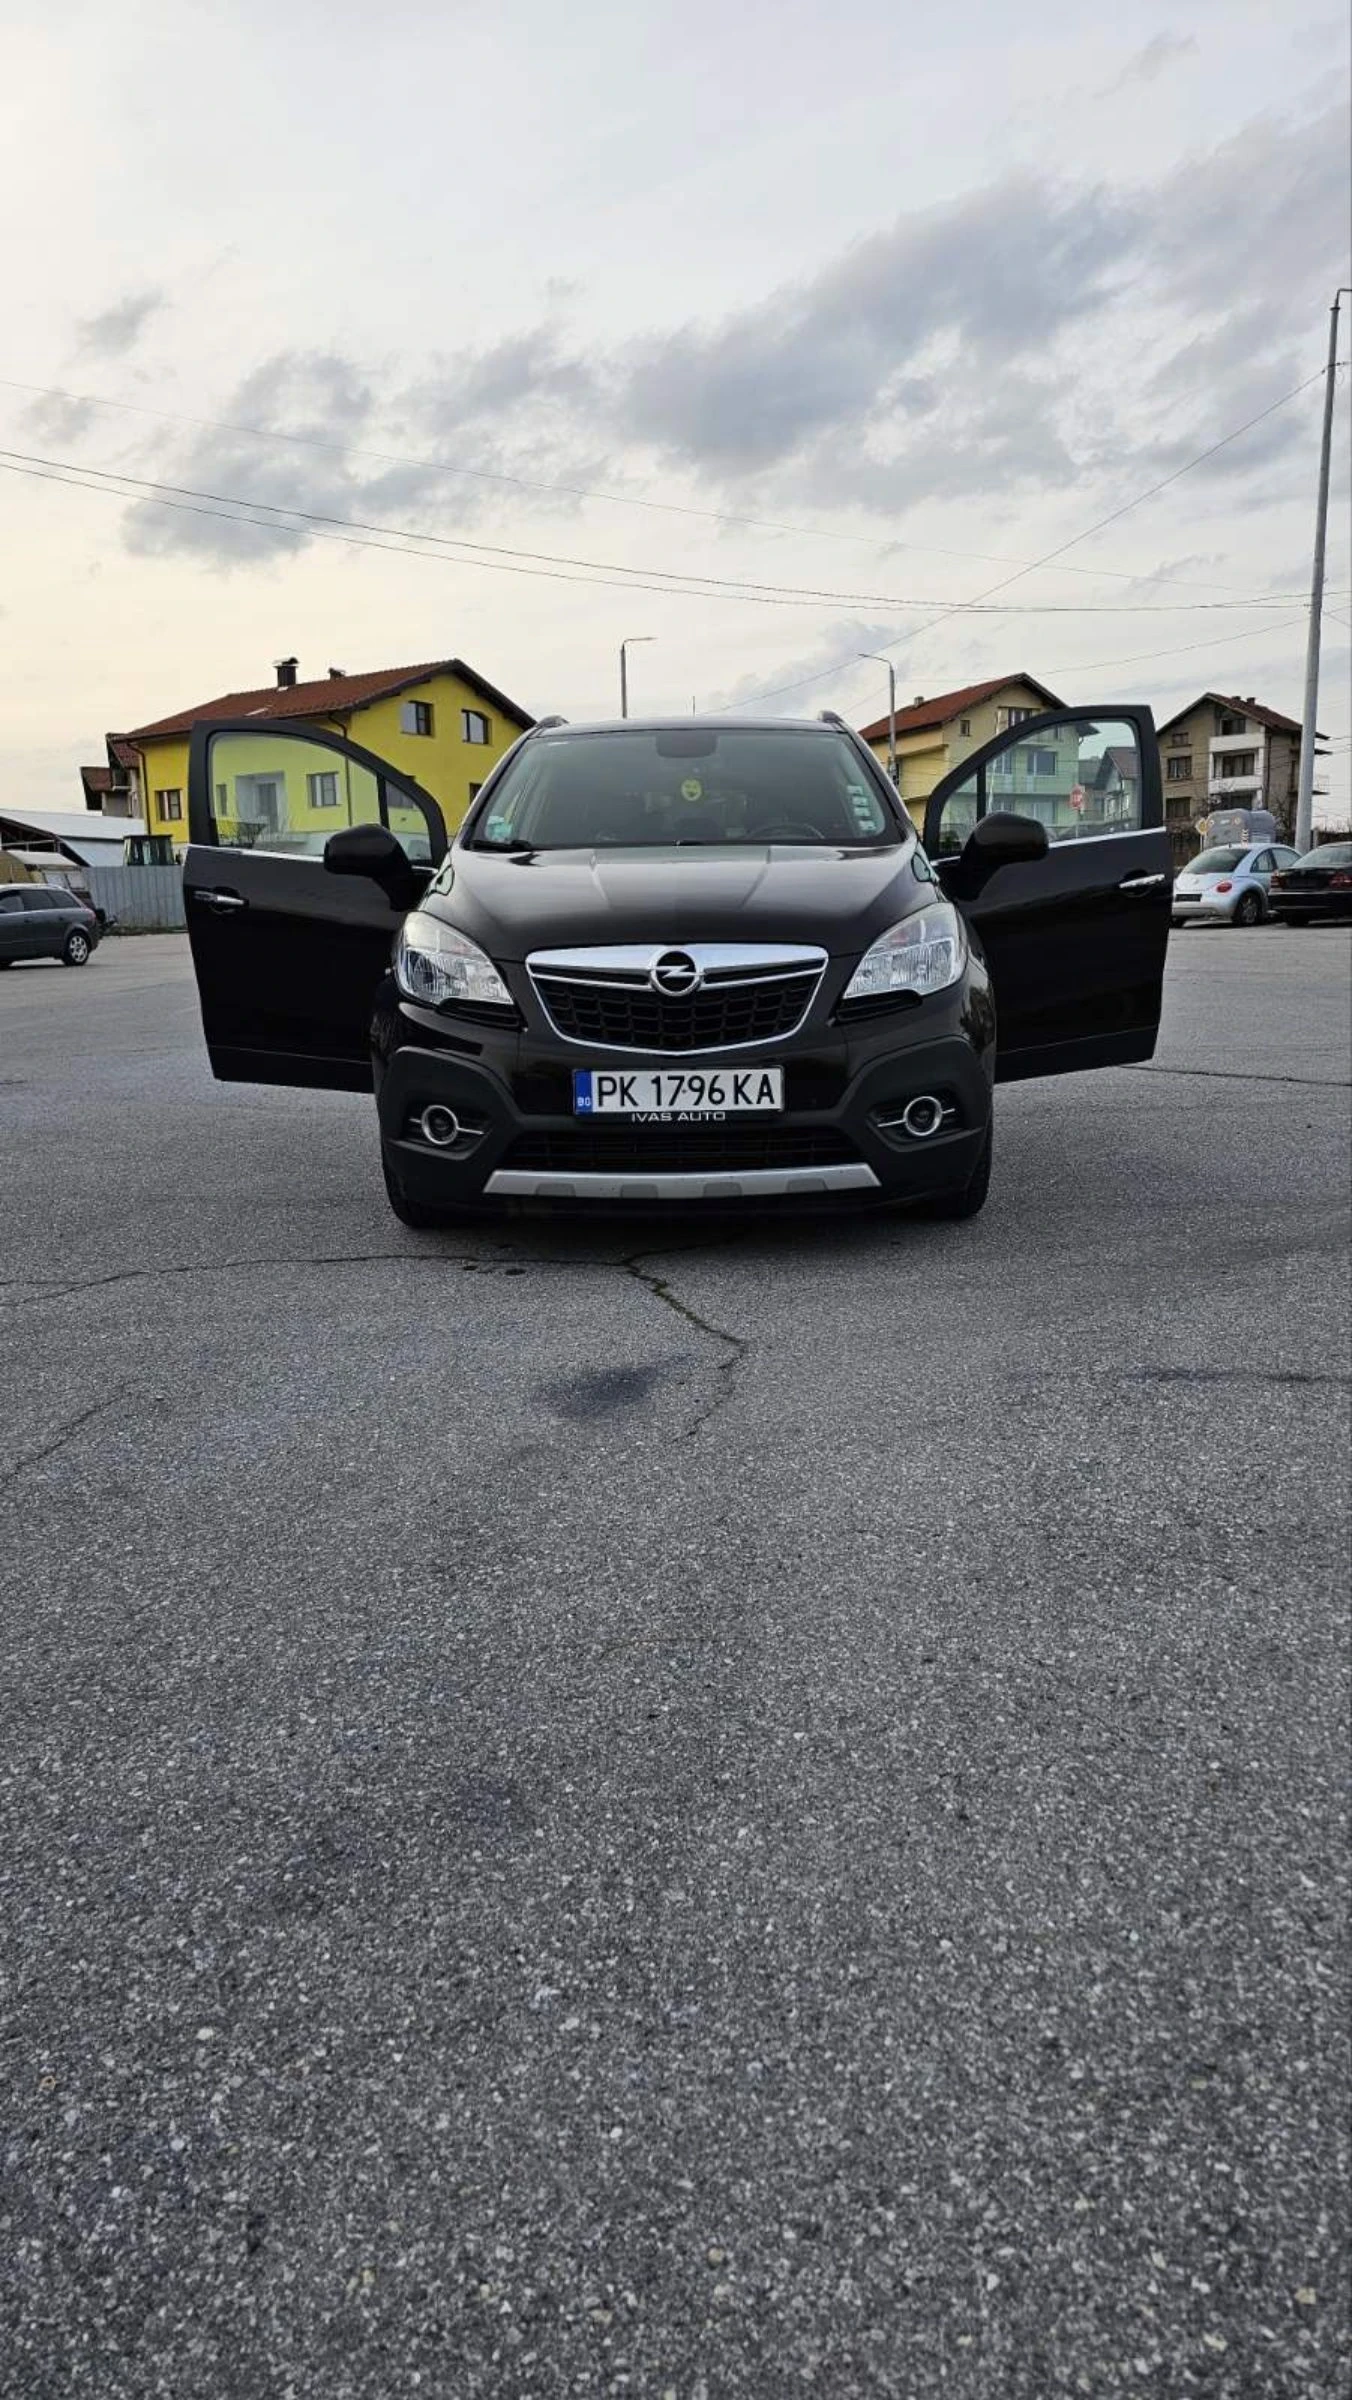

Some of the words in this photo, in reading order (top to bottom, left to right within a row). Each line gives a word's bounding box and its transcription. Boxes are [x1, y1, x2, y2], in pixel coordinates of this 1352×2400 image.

[597, 1076, 639, 1107] PK
[651, 1074, 726, 1106] 1796
[733, 1073, 775, 1105] KA
[631, 1112, 672, 1122] IVAS
[677, 1111, 726, 1121] AUTO
